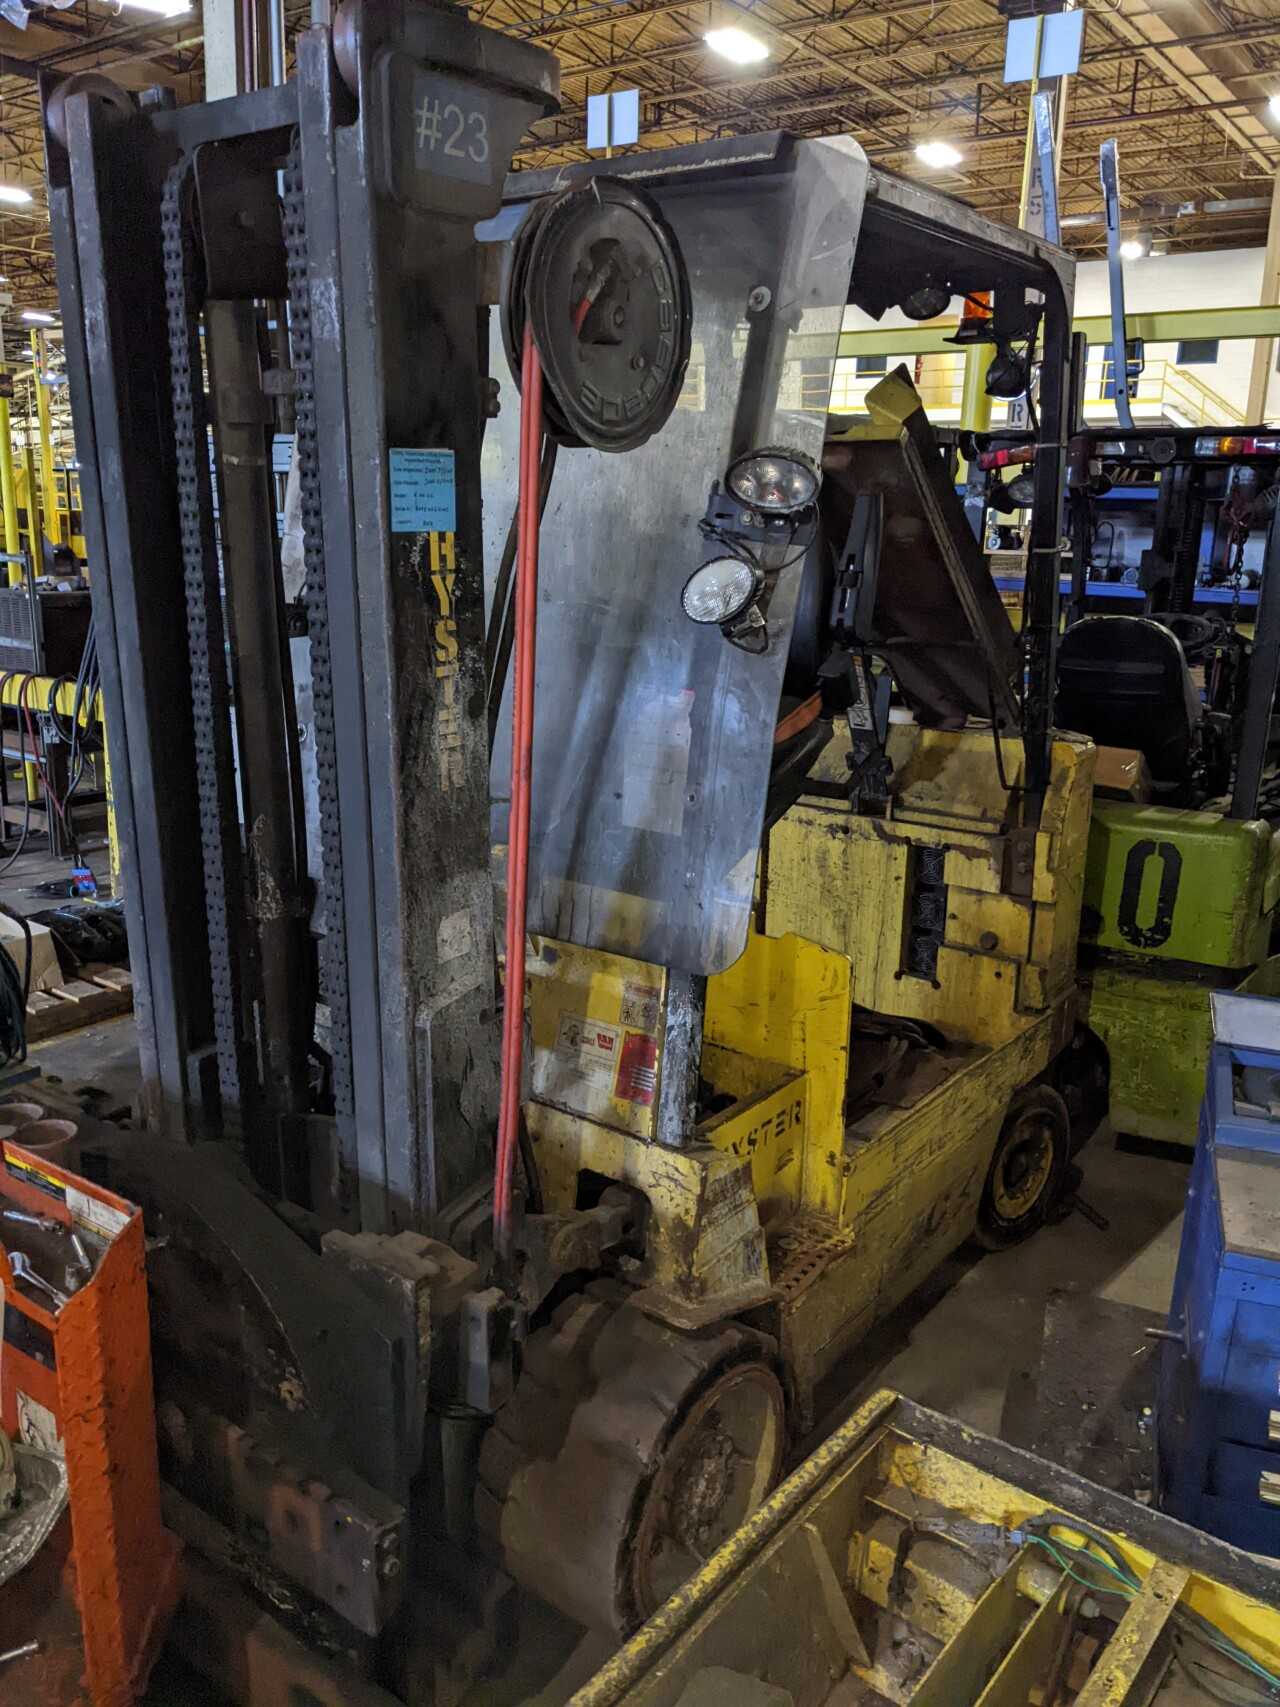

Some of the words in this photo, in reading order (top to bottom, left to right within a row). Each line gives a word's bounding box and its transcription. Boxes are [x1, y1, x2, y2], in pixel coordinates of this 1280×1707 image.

[416, 95, 488, 162] #23
[429, 530, 465, 792] HYSTER
[723, 1099, 802, 1157] YSTER
